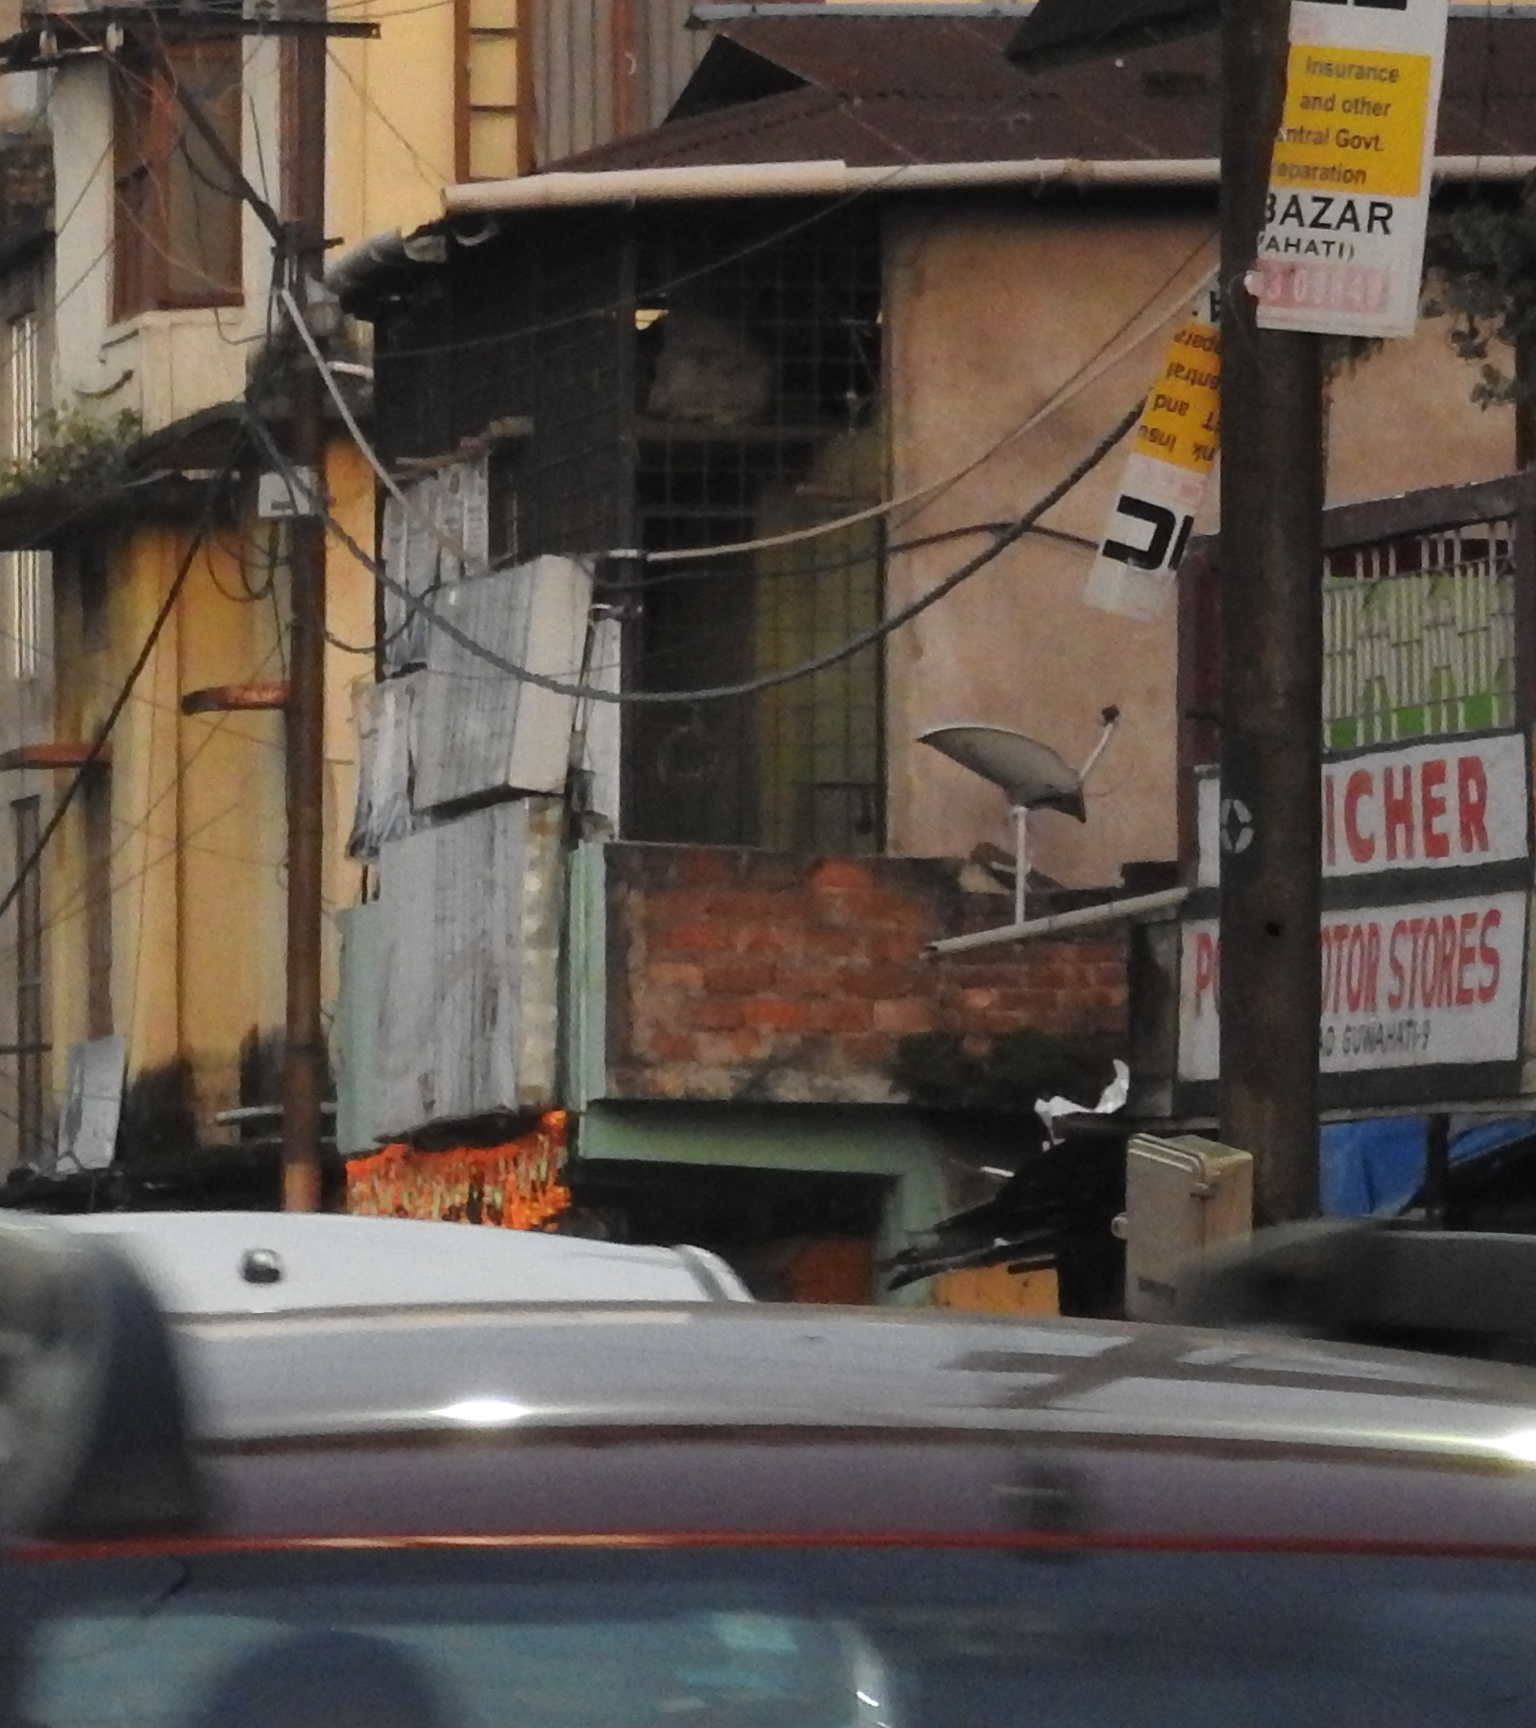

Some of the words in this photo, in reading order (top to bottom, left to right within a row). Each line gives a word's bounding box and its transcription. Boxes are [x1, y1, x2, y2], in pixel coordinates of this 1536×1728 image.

[1306, 55, 1400, 84] Insurance
[1300, 93, 1335, 113] and
[1342, 95, 1392, 118] other
[1335, 127, 1385, 153] Govt.
[1154, 393, 1190, 418] and
[1324, 756, 1491, 866] ICHER
[1388, 908, 1502, 1011] STORES
